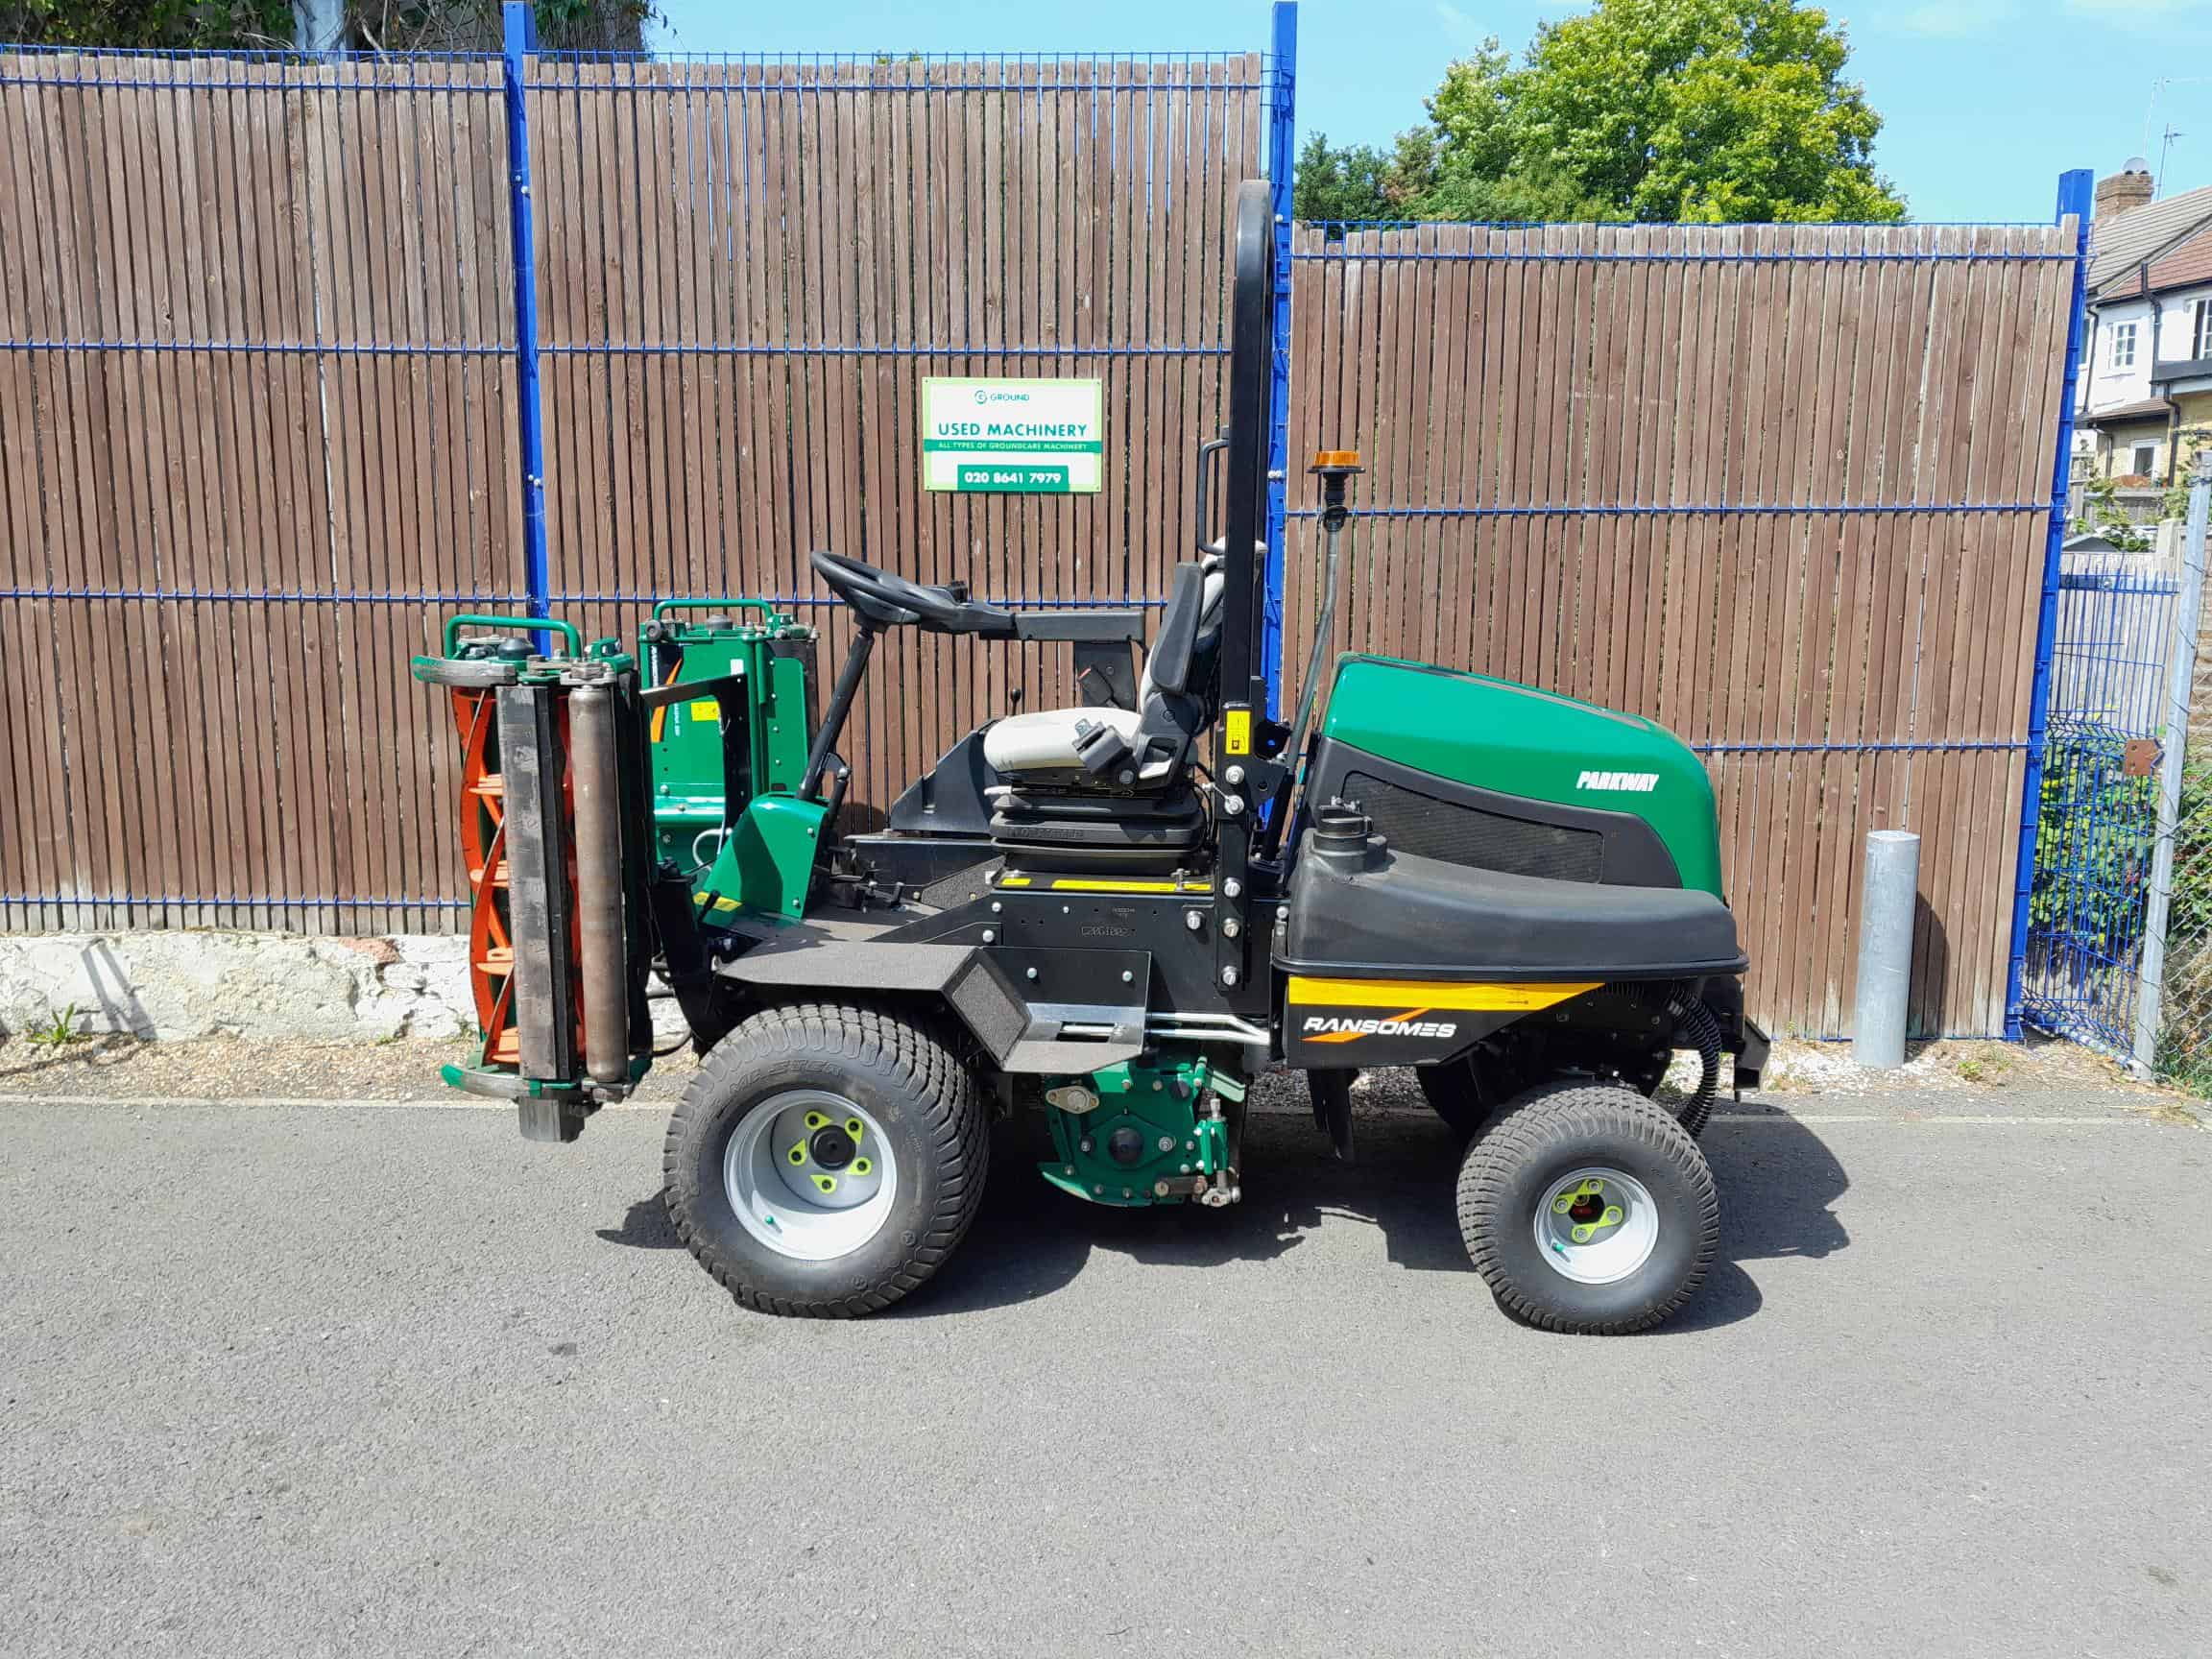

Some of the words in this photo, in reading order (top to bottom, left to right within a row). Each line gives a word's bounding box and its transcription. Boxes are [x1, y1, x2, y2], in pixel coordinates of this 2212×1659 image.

[990, 393, 1030, 401] GROUND
[938, 422, 980, 436] USED
[987, 423, 1088, 437] MACHINERY
[964, 471, 990, 484] 020
[993, 471, 1023, 484] 8641
[1028, 471, 1062, 484] 7979
[1575, 771, 1659, 792] PARKWAY
[1303, 1017, 1456, 1038] RANSOMES
